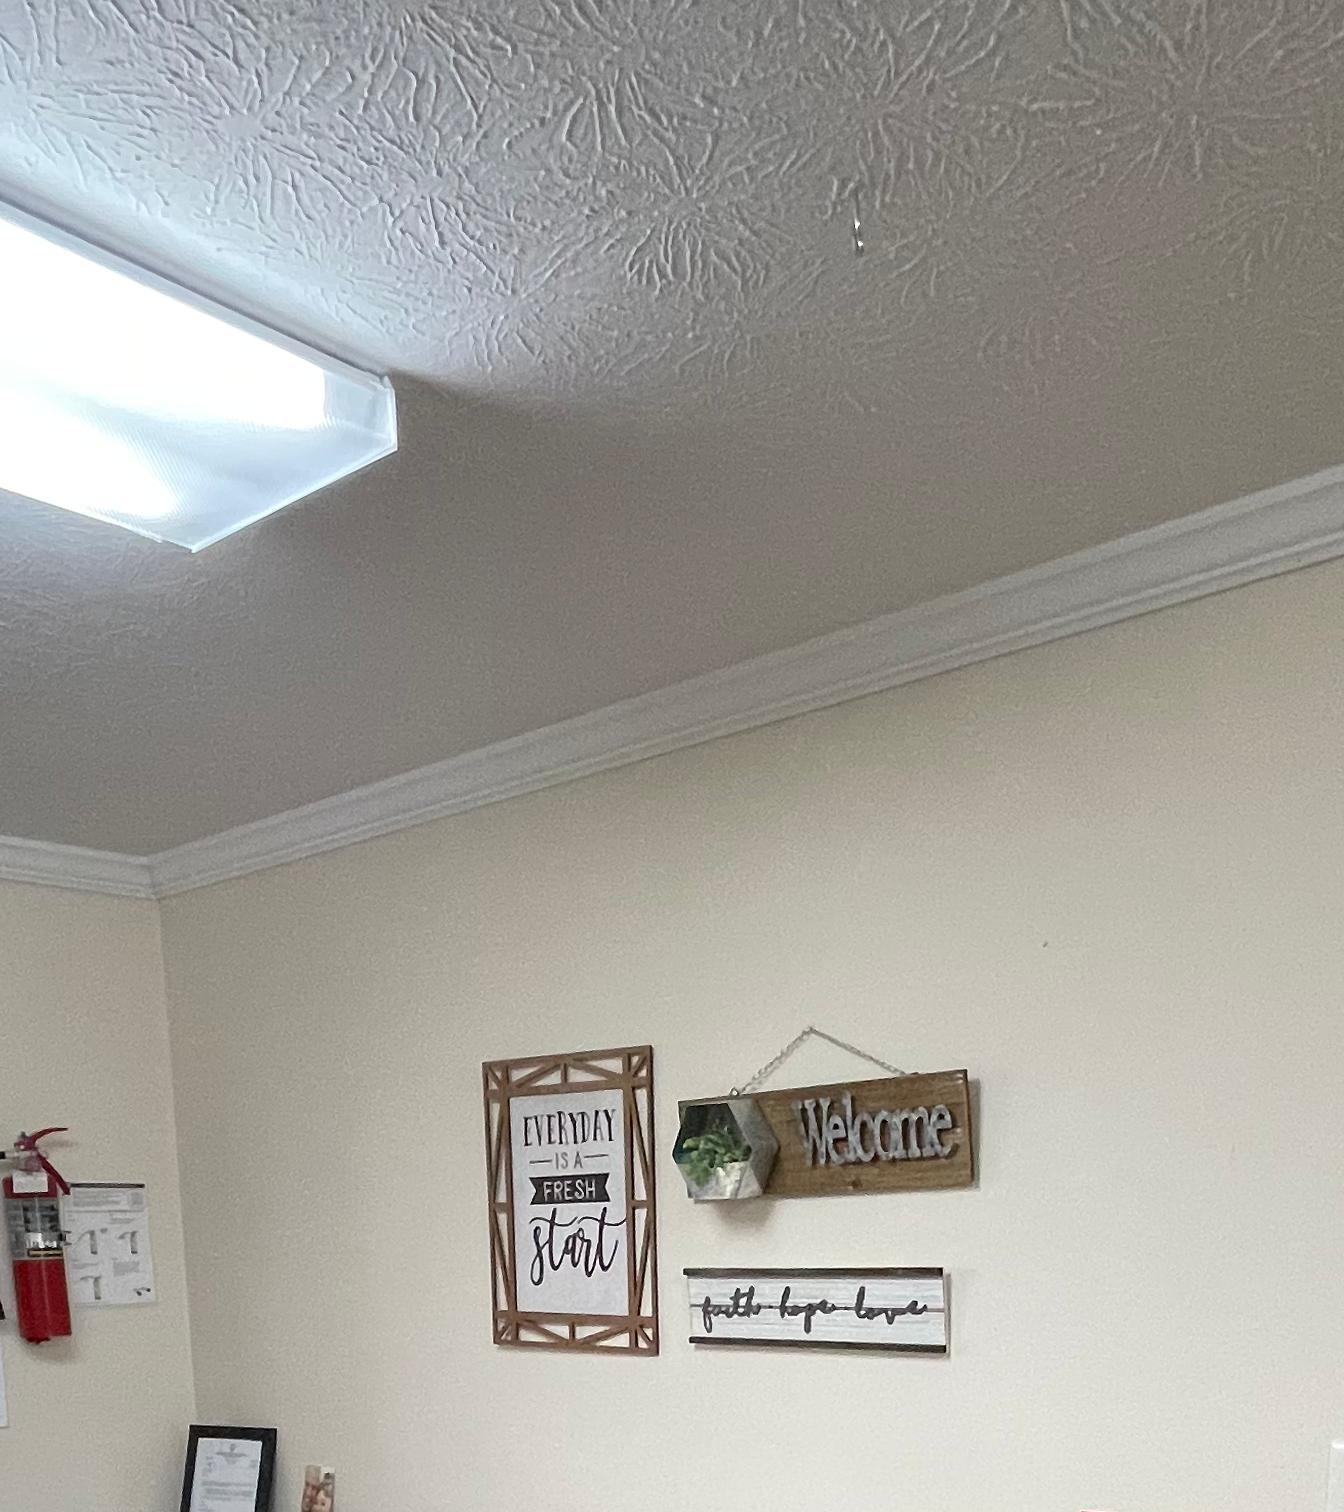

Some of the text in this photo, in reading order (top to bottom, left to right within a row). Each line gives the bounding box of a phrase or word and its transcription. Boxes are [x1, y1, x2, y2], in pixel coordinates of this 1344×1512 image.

[523, 1108, 616, 1147] EVERYDAY
[793, 1090, 956, 1167] Welcome
[555, 1151, 584, 1171] IS A
[543, 1178, 597, 1202] FRESH
[529, 1206, 626, 1286] start
[703, 1285, 928, 1334] faith hope love
